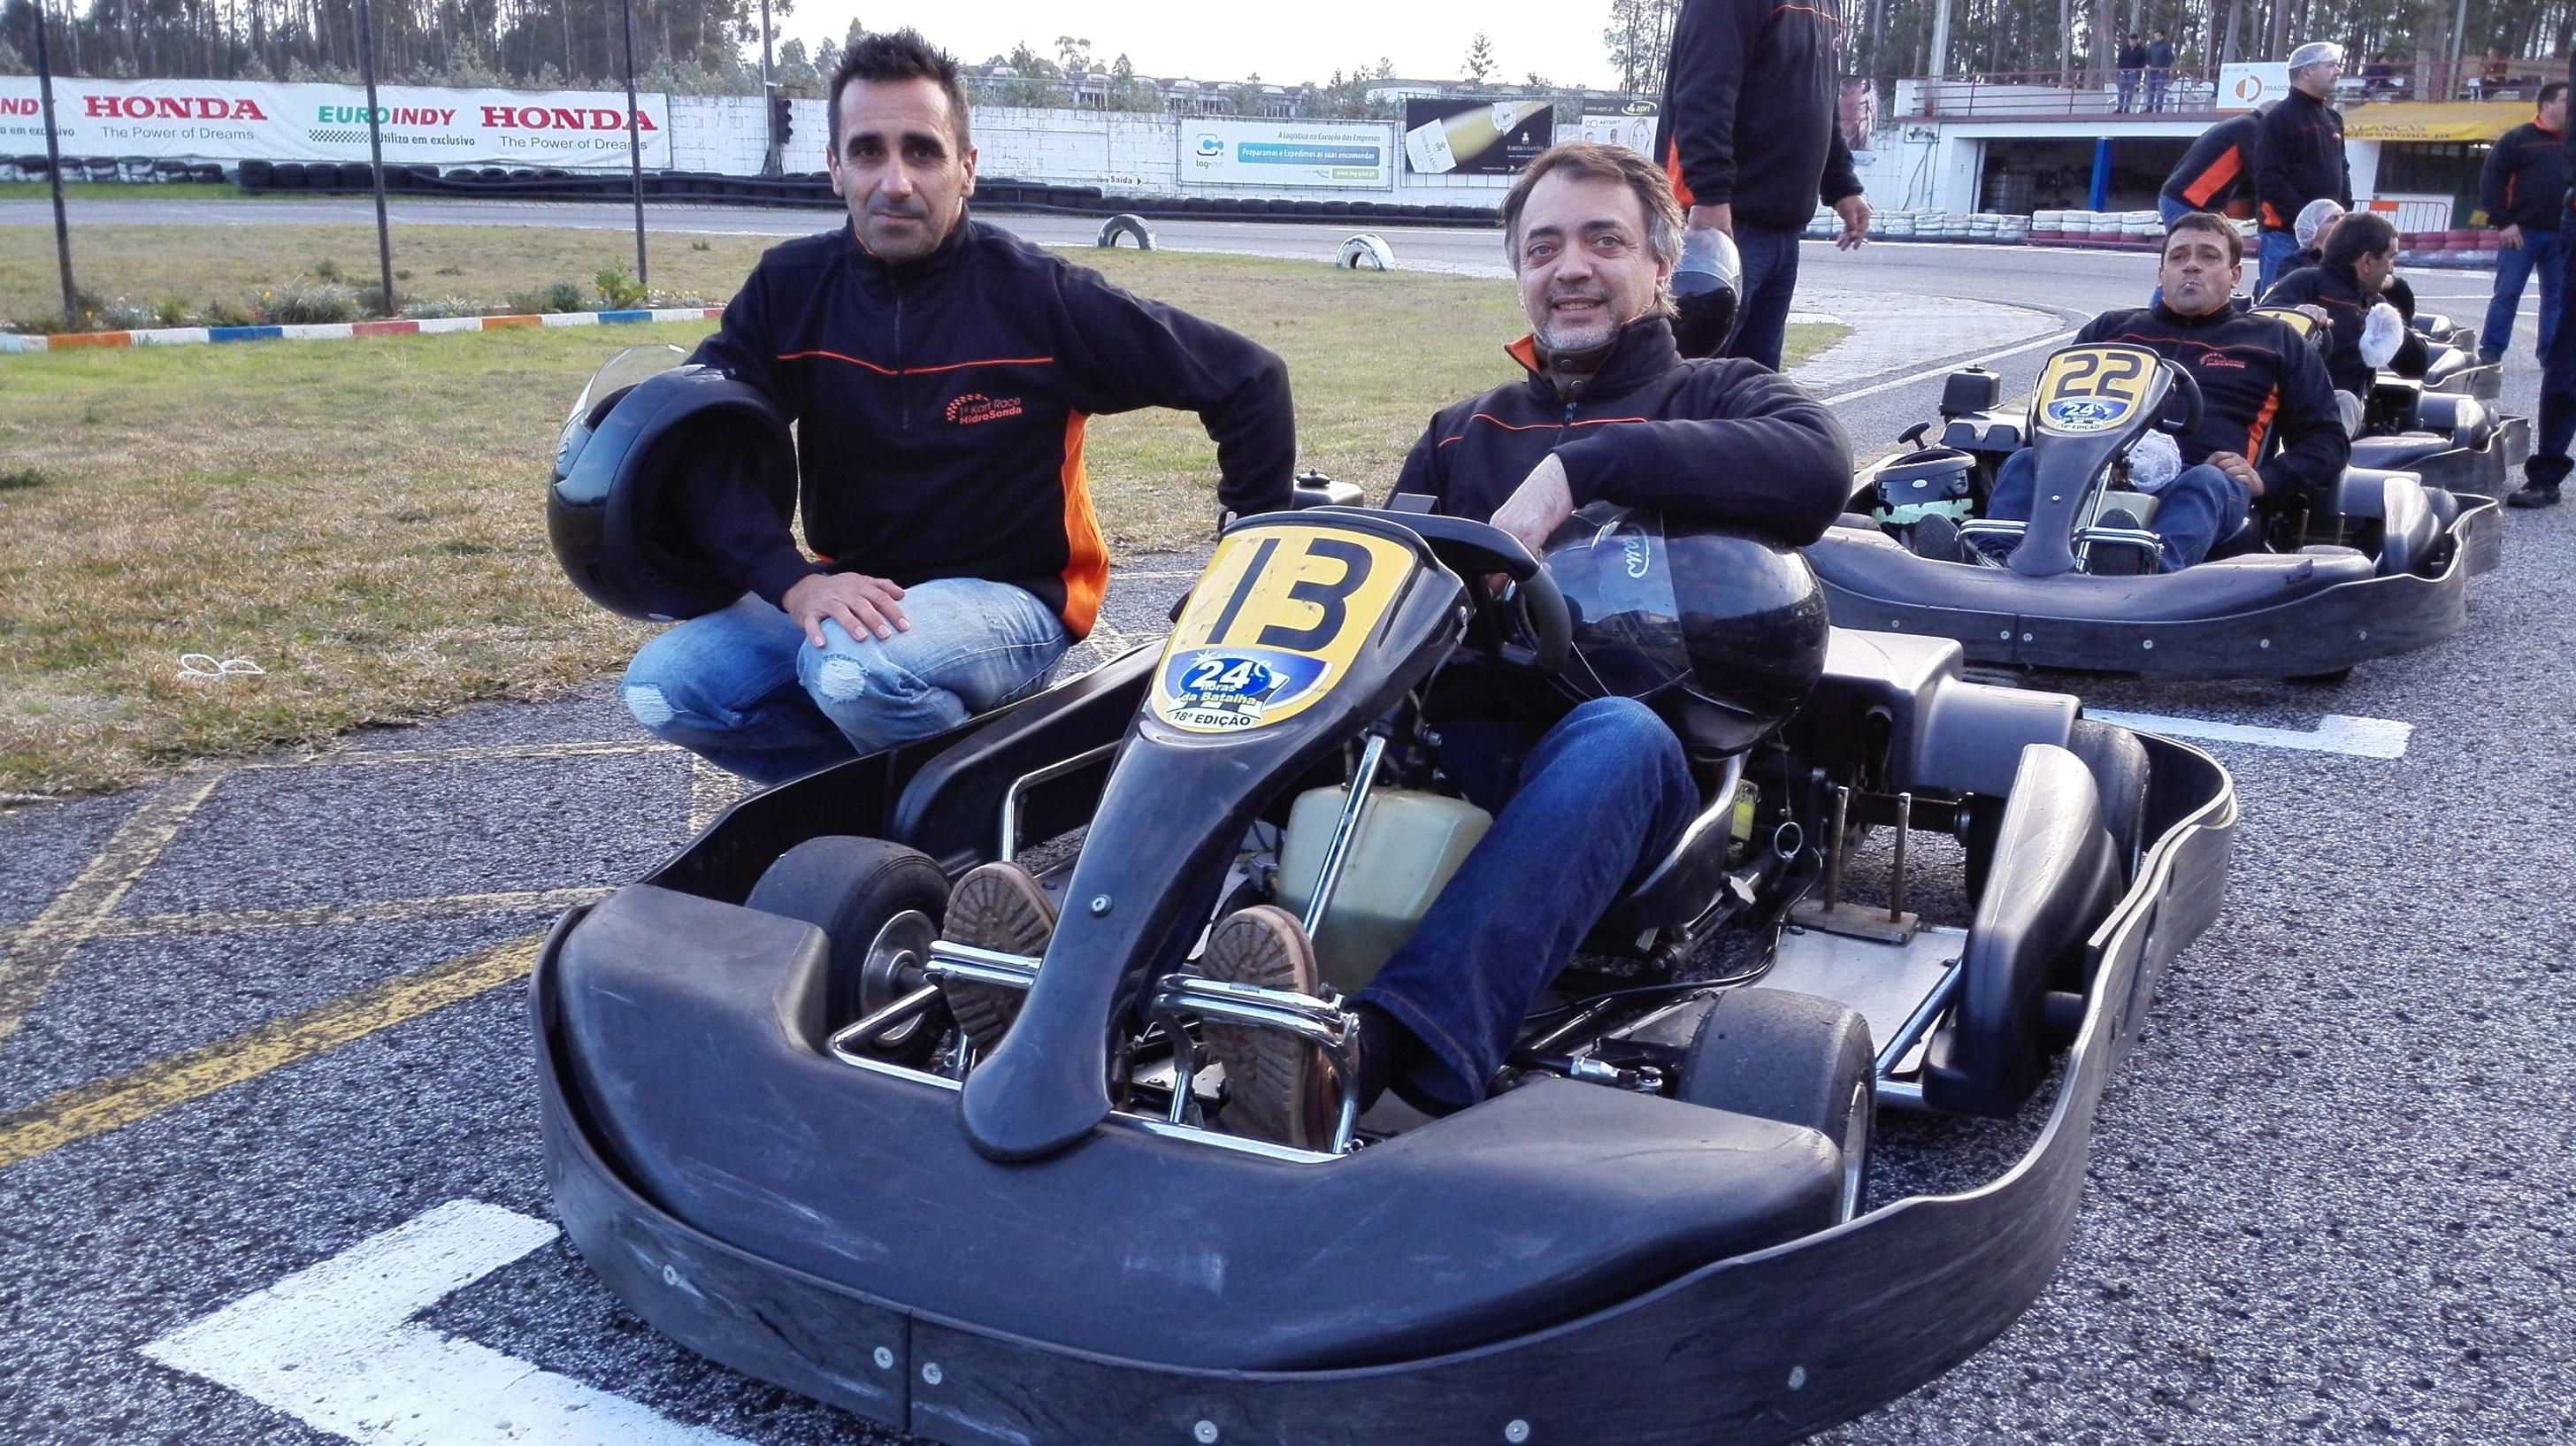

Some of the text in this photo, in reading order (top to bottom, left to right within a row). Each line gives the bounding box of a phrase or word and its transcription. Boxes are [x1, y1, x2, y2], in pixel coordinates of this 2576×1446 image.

[82, 96, 268, 120] HONDA
[318, 105, 456, 126] EUROINDY
[480, 106, 658, 131] HONDA
[100, 126, 254, 140] The Power of Dreams
[430, 134, 476, 146] exclusivo
[500, 135, 526, 147] The
[531, 136, 573, 149] Power
[578, 137, 590, 149] of
[1242, 149, 1278, 157] Preparamos
[1284, 149, 1316, 159] Expedimos
[2053, 353, 2142, 401] 22
[970, 402, 991, 415] Kart
[993, 397, 1020, 409] Race
[2064, 403, 2095, 416] 24
[959, 406, 1022, 425] HidroSonda
[1205, 537, 1373, 653] 13
[1189, 660, 1254, 690] 24
[1181, 692, 1257, 706] da Batalha
[1194, 714, 1251, 727] EDIÇÃO
